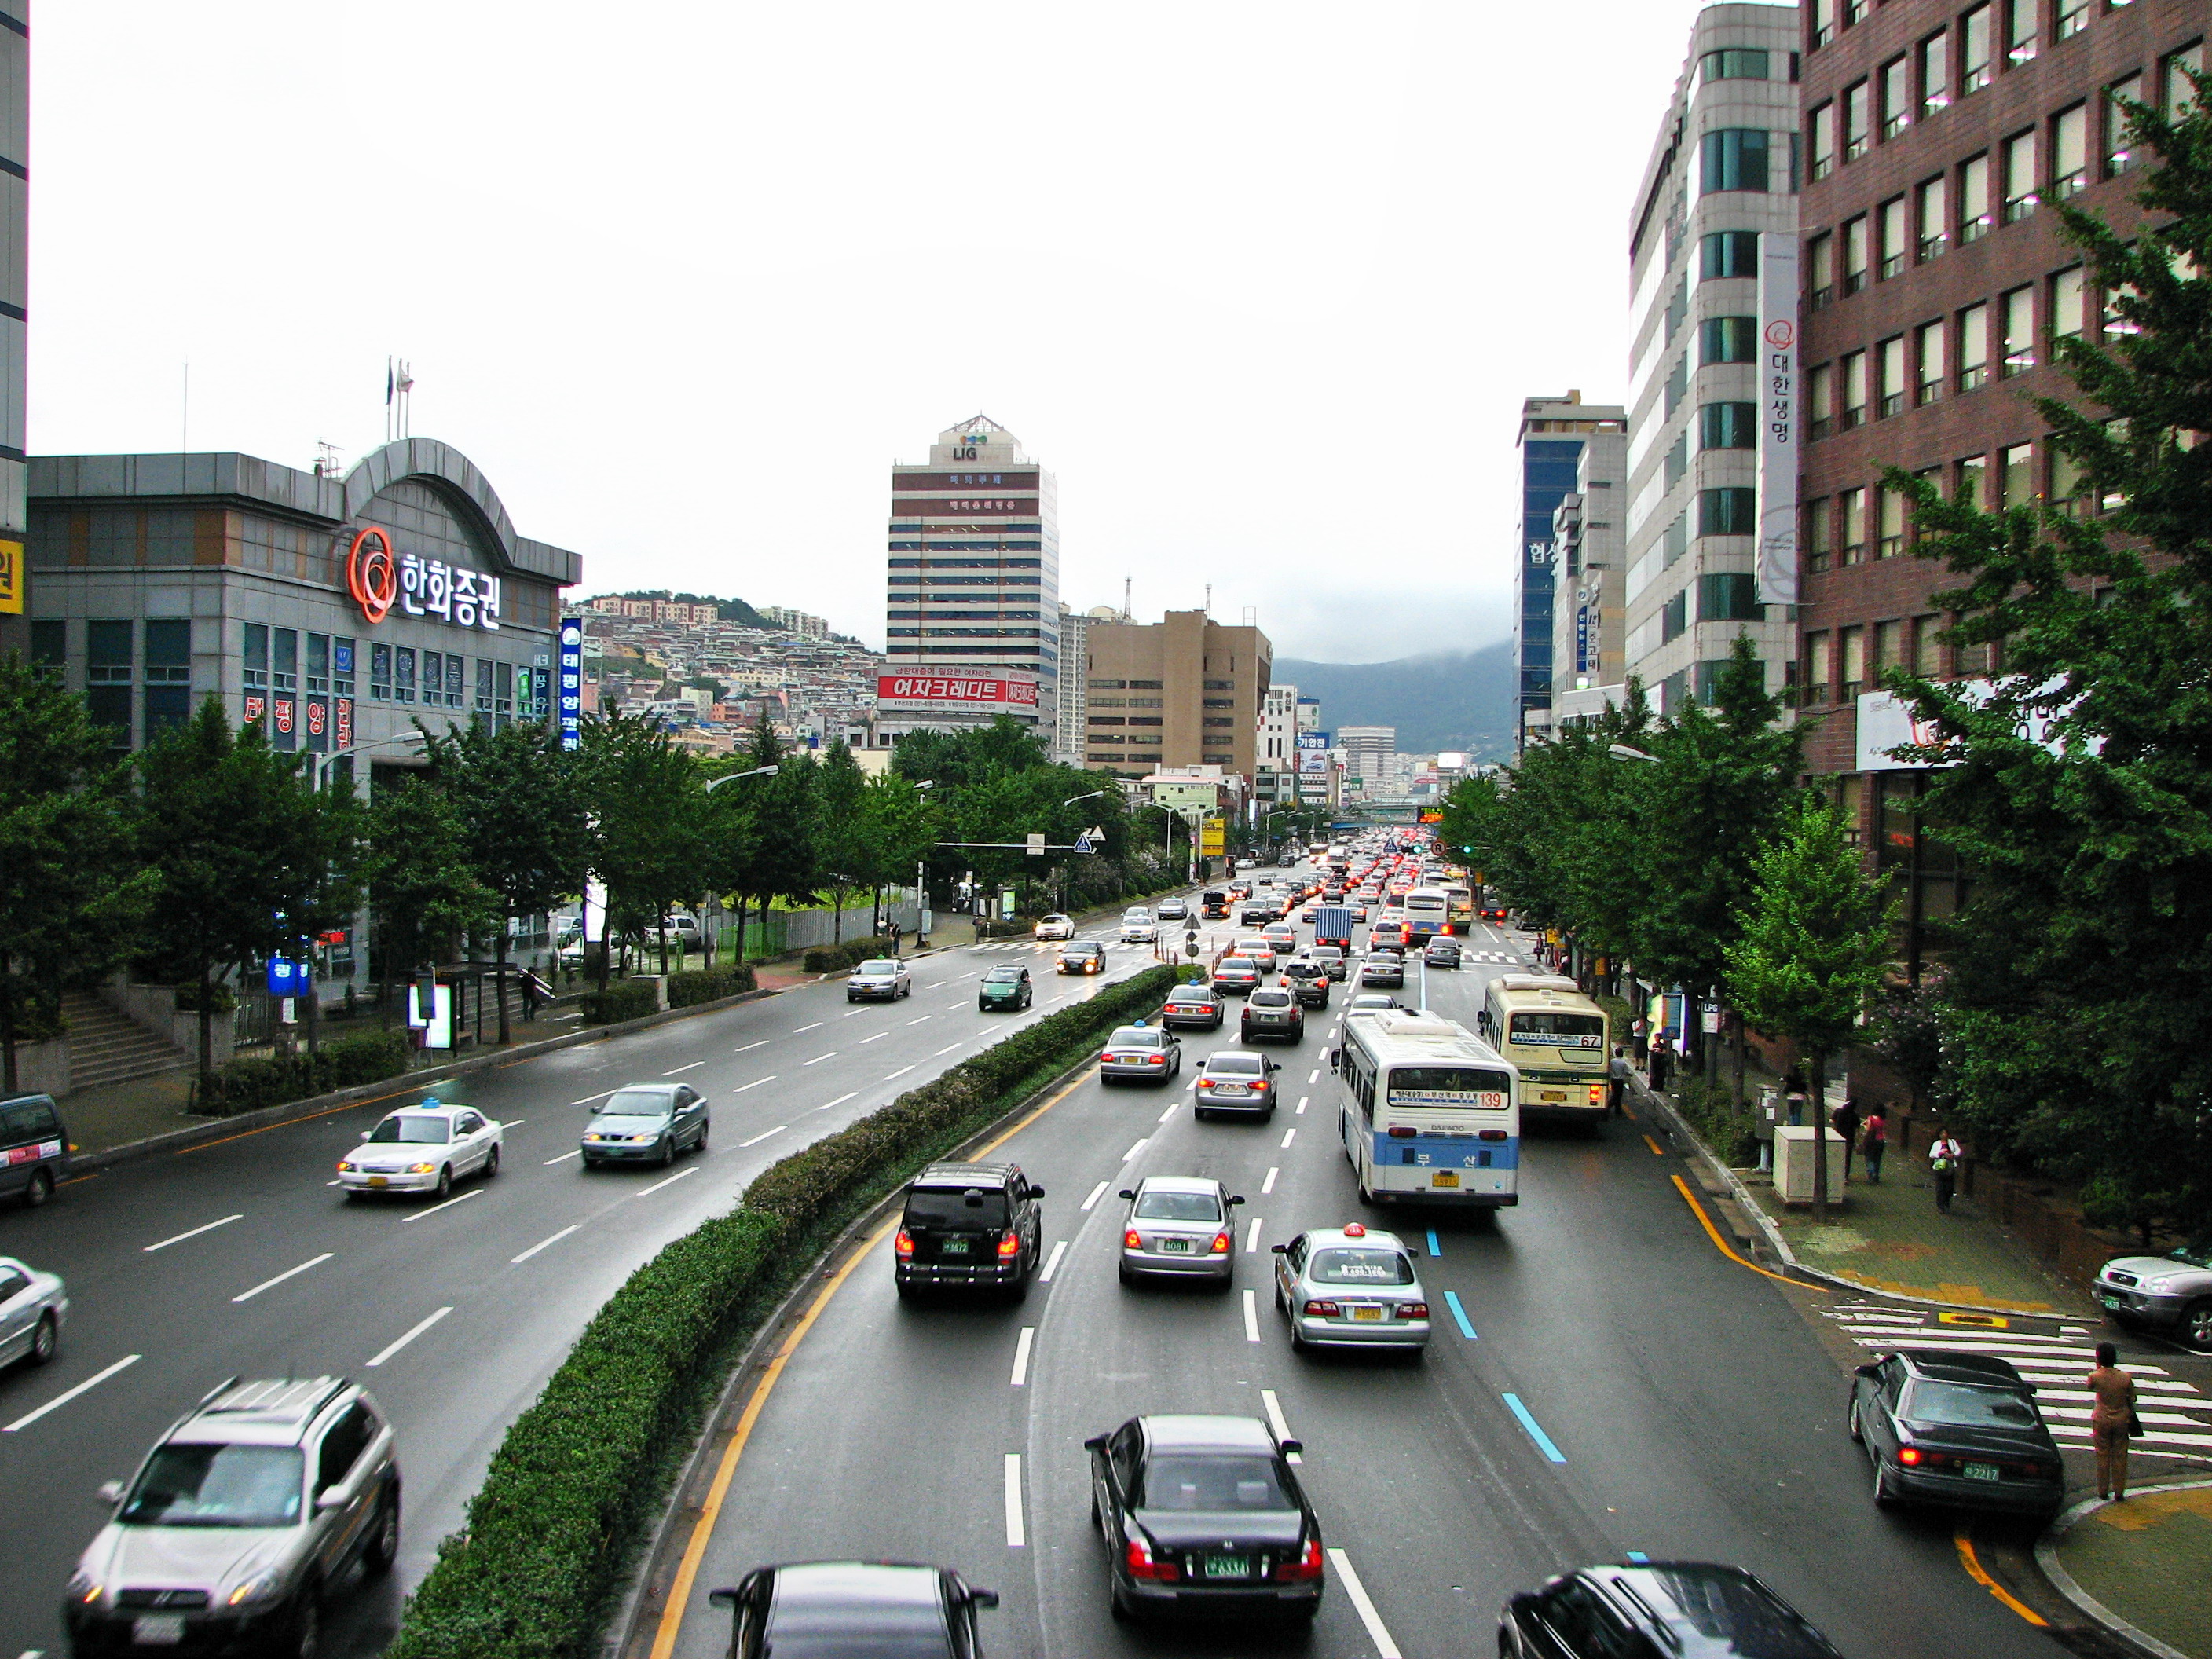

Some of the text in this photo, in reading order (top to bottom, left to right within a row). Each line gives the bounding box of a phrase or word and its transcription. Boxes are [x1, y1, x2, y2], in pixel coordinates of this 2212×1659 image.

[1771, 353, 1789, 443] 대한생명
[953, 447, 976, 460] LIG
[400, 553, 500, 631] 한화증권
[939, 668, 961, 676] 필요한
[893, 679, 998, 699] 여자크레디트
[562, 654, 580, 752] 태평양관광
[1704, 1003, 1718, 1012] LPG
[1581, 1036, 1598, 1046] 67
[1480, 1093, 1500, 1107] 139
[1418, 1154, 1430, 1166] 부
